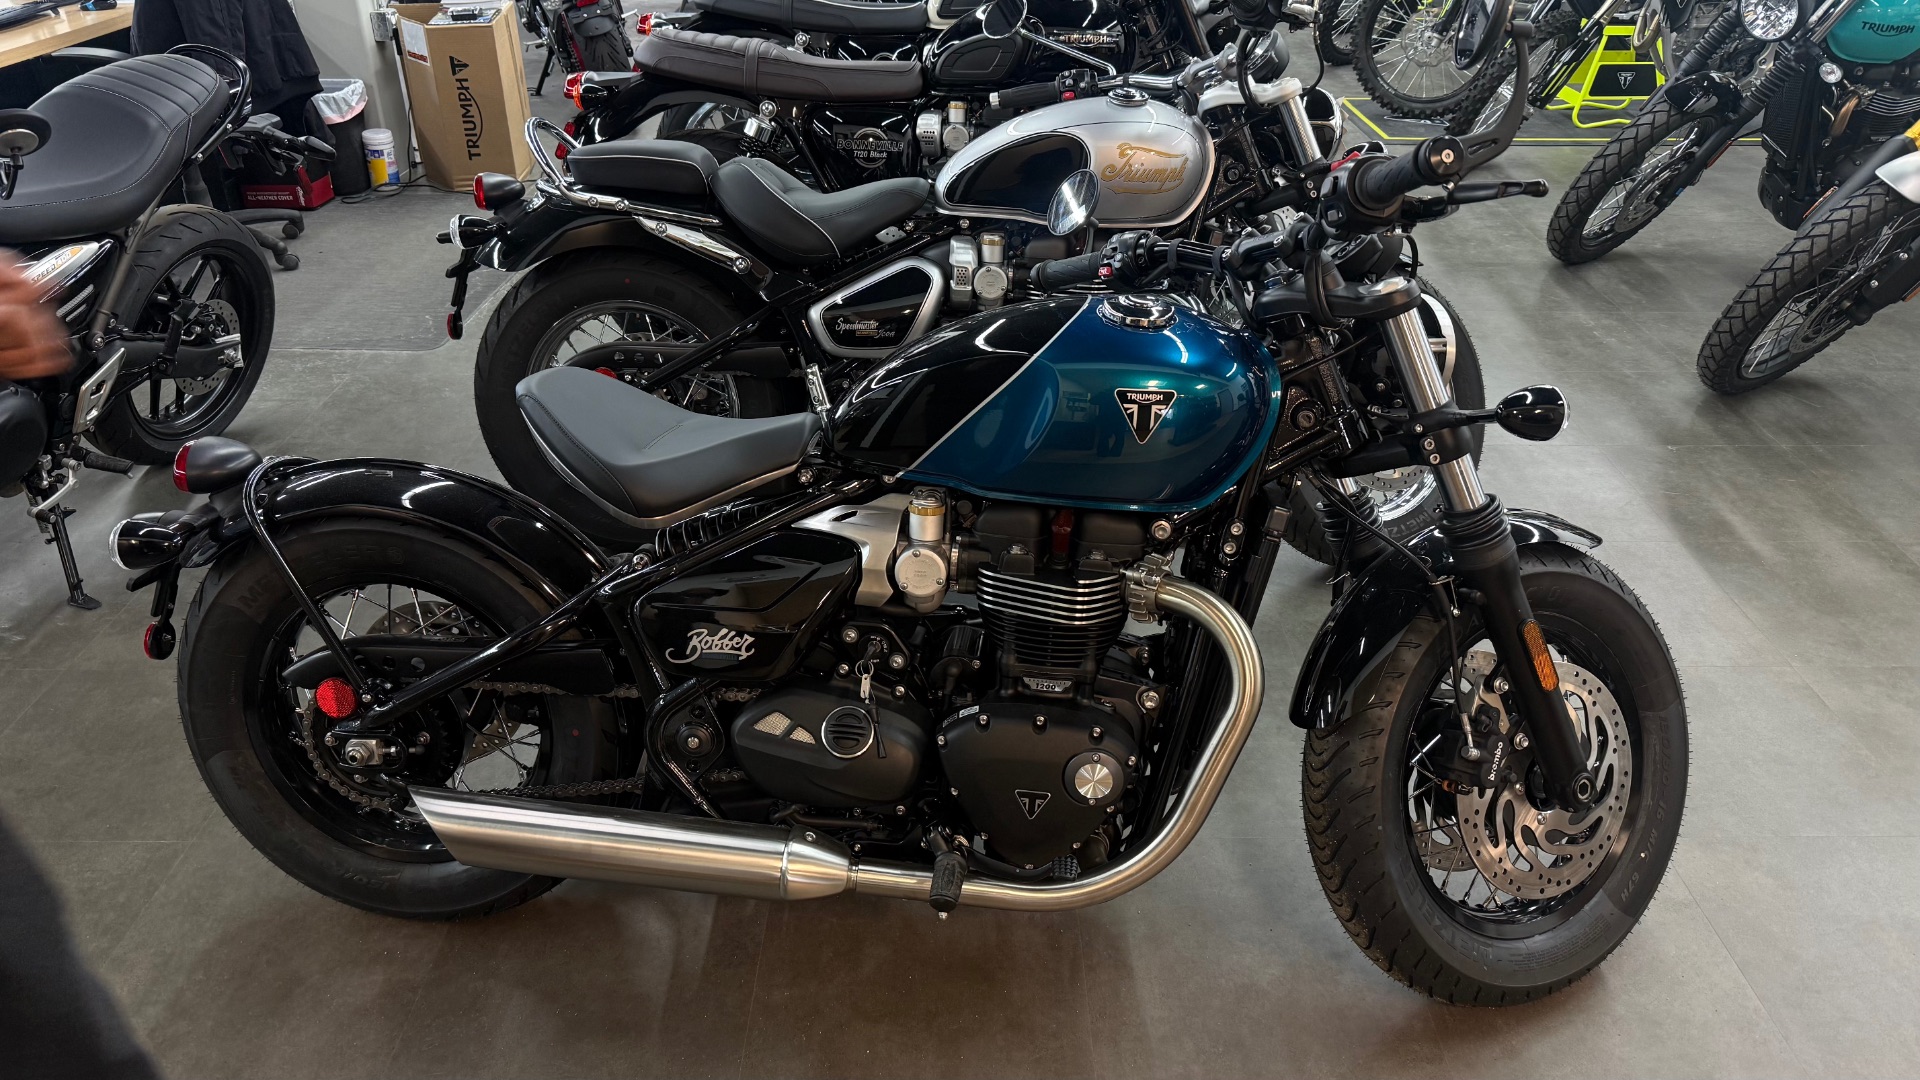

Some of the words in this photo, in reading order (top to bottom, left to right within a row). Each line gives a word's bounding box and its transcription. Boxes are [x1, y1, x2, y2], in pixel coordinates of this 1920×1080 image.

[1861, 20, 1916, 37] TRIUMPH
[1064, 33, 1107, 46] TRIUMPH
[455, 78, 484, 161] TRIUMPH
[836, 138, 904, 152] BONNEVILLE
[853, 150, 868, 158] T120
[1100, 142, 1190, 195] Triumph
[835, 316, 879, 335] Speedmaster
[1126, 392, 1164, 404] TRIUMPH
[664, 627, 756, 664] Bobber
[1035, 682, 1057, 691] 1200
[1487, 741, 1504, 781] brembo
